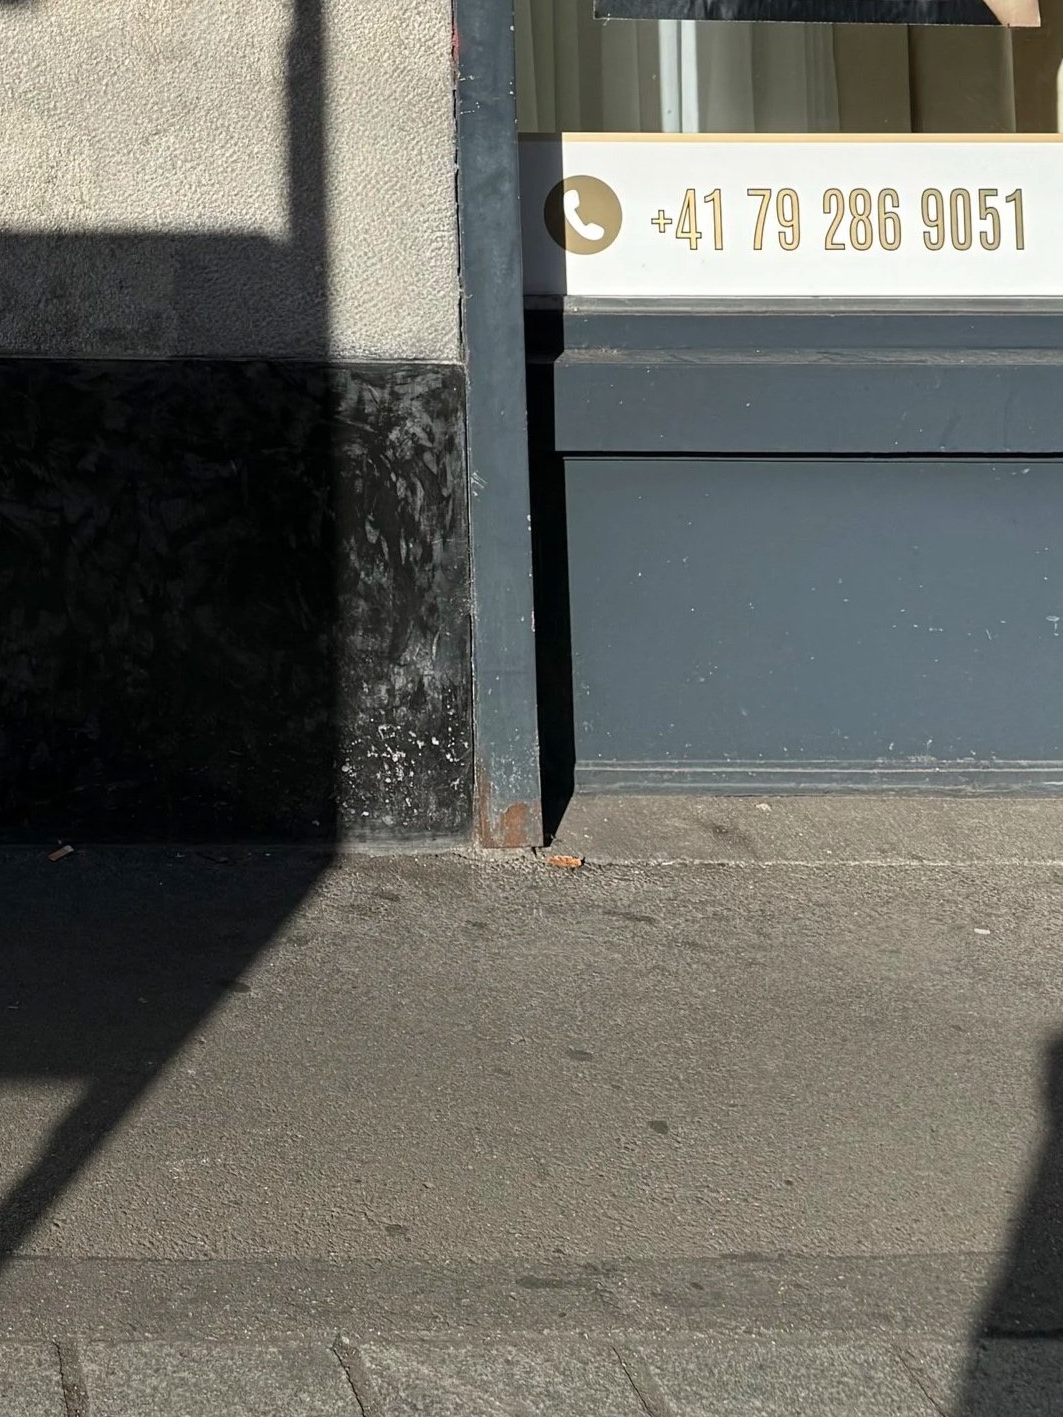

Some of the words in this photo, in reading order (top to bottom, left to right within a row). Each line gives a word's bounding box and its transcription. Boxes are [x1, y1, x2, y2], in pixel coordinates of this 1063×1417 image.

[651, 189, 723, 250] +41
[747, 188, 800, 251] 79
[823, 188, 901, 251] 286
[921, 188, 1024, 251] 9051
